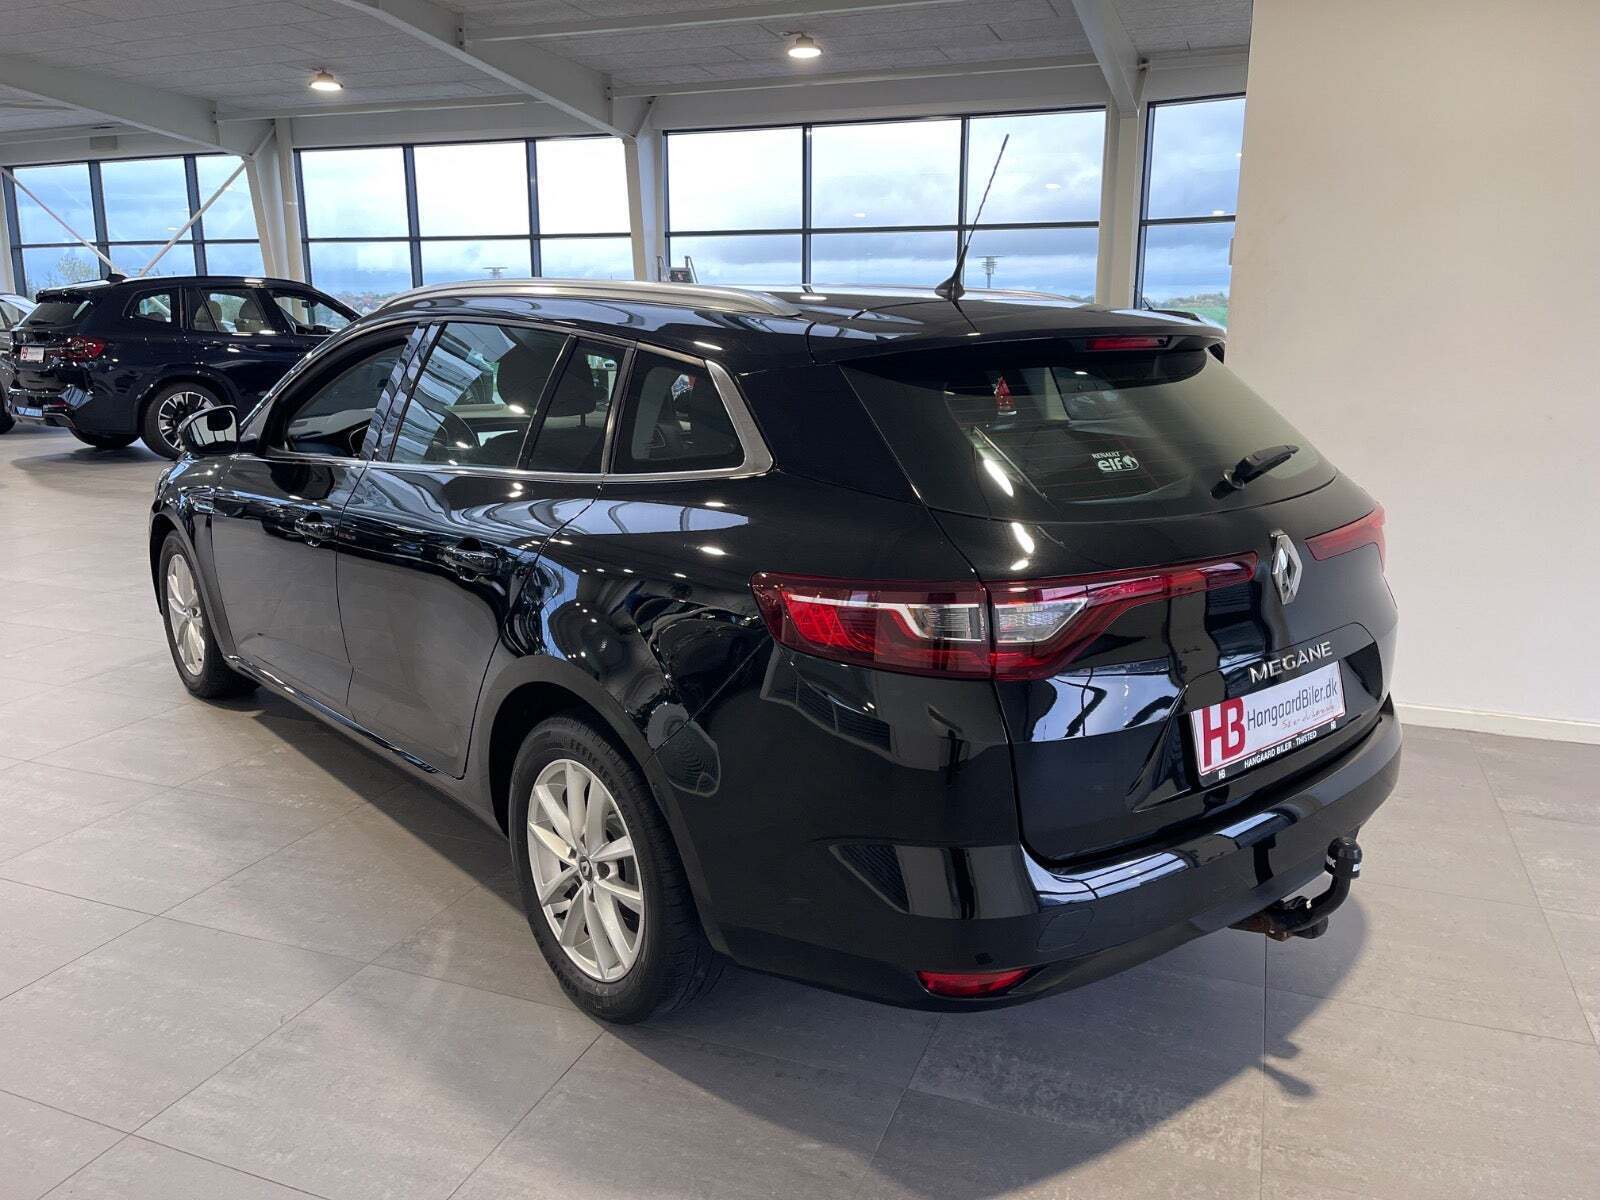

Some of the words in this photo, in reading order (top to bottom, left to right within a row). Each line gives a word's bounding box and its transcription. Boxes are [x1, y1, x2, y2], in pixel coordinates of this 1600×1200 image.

[1248, 641, 1333, 684] MEGANE
[1247, 676, 1338, 731] HangaardBiler.dk
[1201, 696, 1246, 768] HB
[1244, 748, 1276, 768] HANGAARD
[1276, 741, 1292, 756] BILER
[1295, 730, 1317, 746] THISTED
